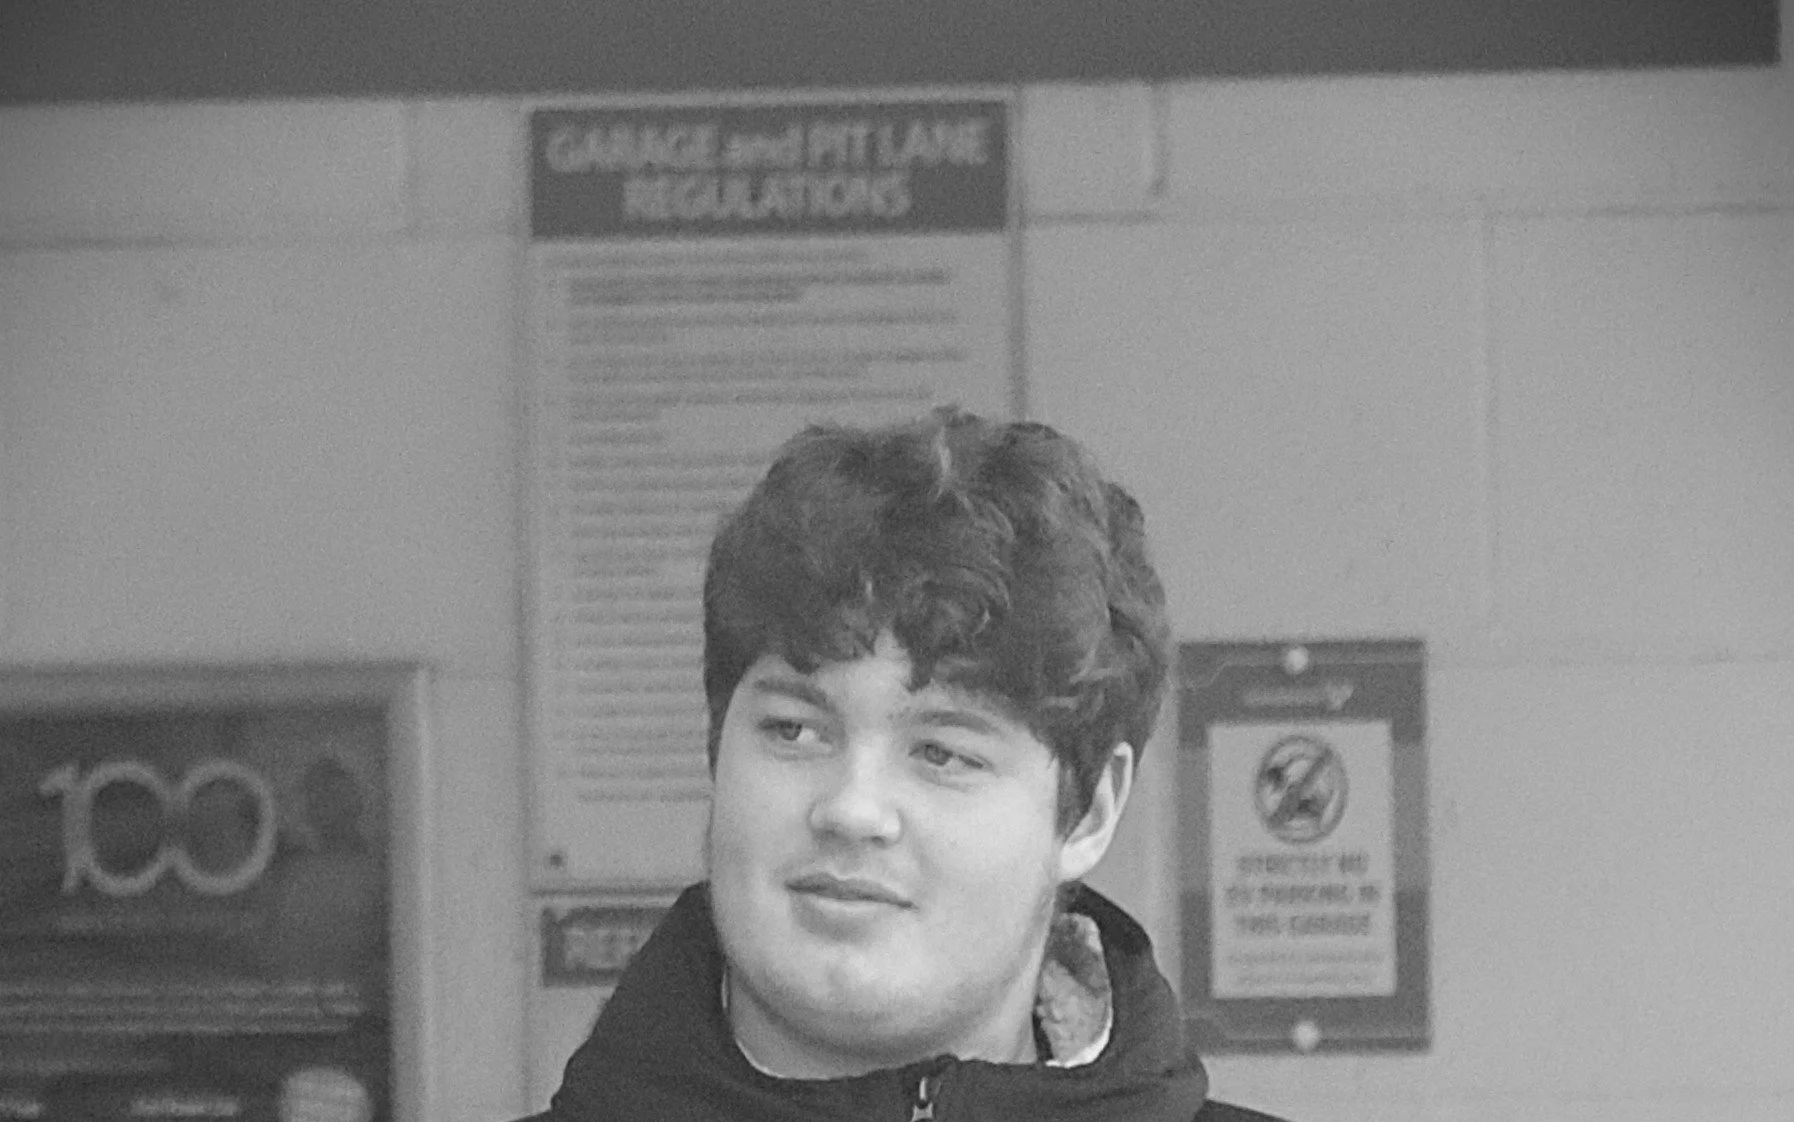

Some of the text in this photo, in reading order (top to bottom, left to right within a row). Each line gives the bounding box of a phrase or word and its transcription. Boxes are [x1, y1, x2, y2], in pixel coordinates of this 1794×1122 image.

[545, 117, 989, 172] GARAGE and PIT LANE
[622, 170, 912, 220] REGULATIONS
[40, 760, 275, 895] 100
